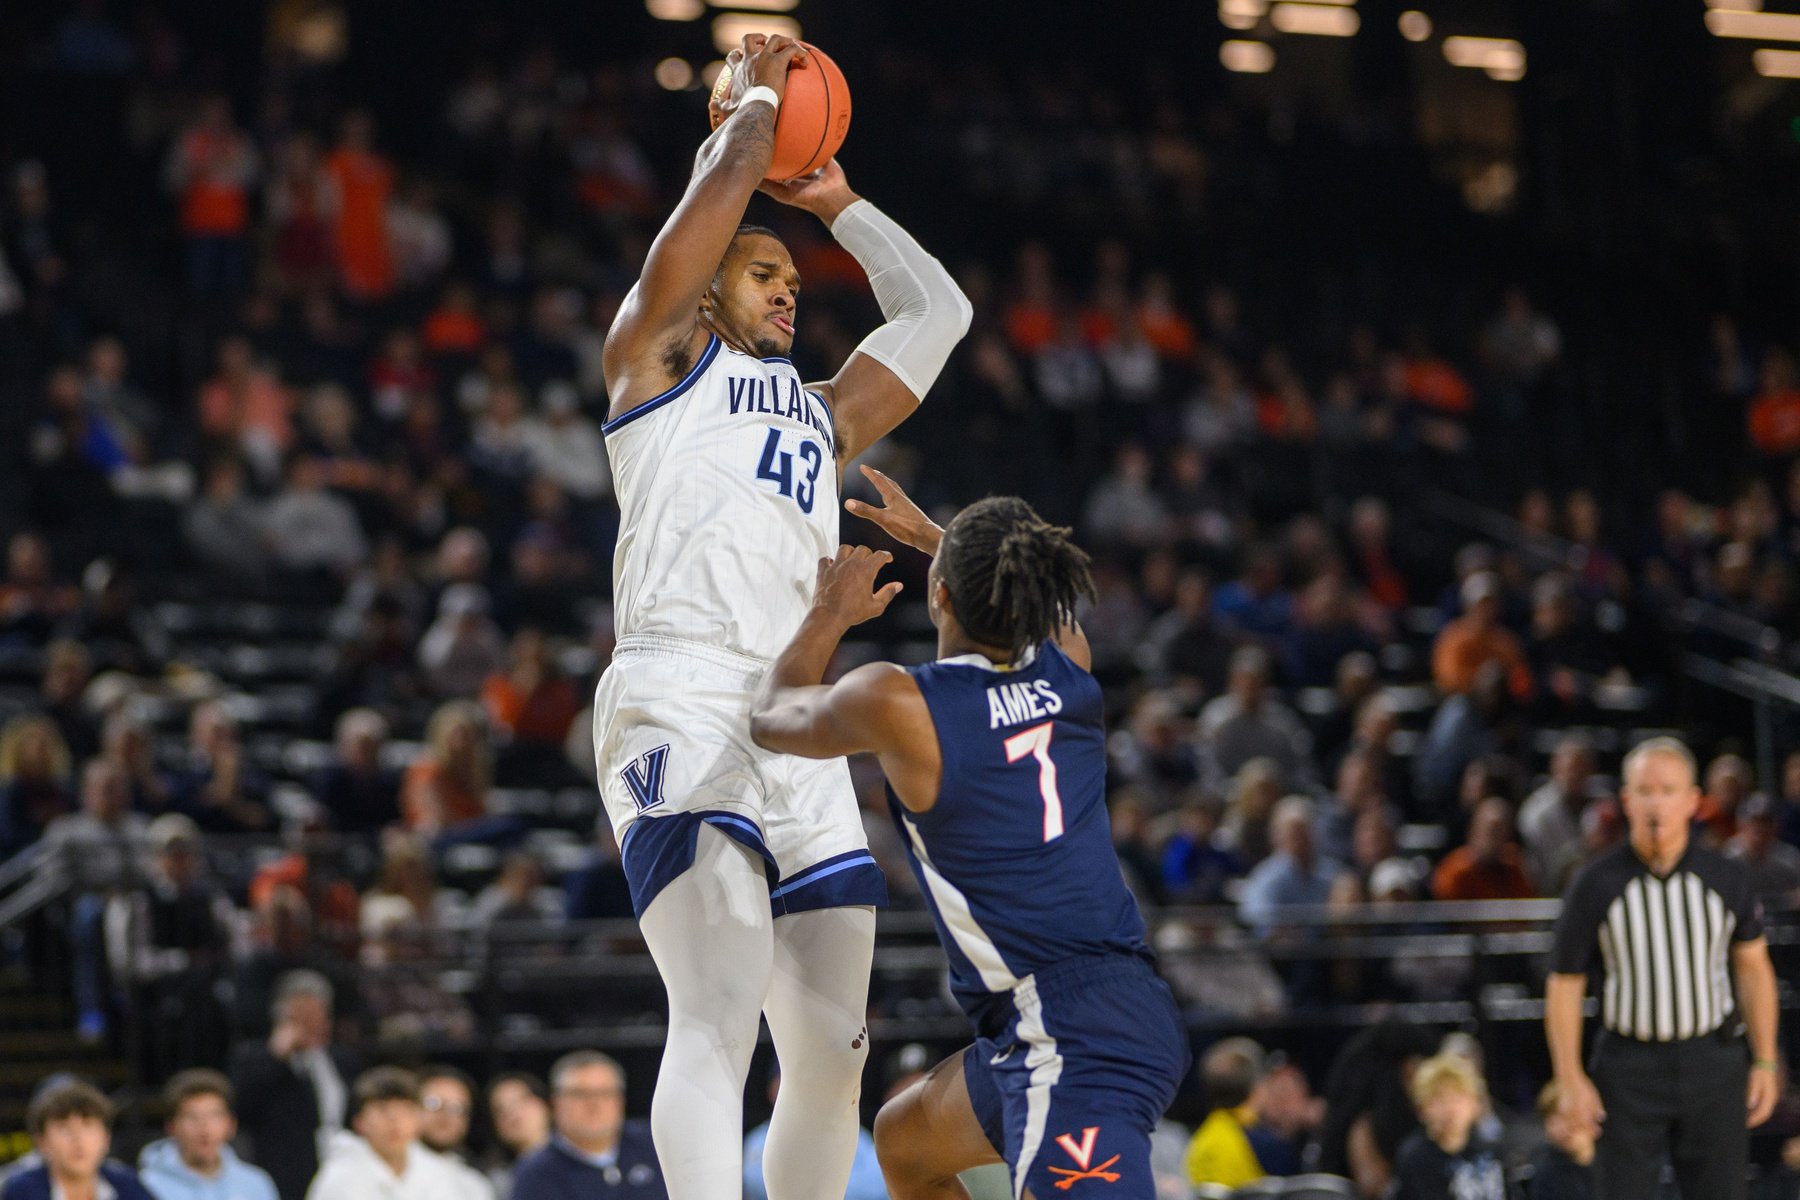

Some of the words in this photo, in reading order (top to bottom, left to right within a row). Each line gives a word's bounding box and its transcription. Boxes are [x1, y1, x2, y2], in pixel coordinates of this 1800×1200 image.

[756, 425, 822, 515] 43
[986, 678, 1063, 730] AMES
[620, 743, 671, 816] V
[1003, 720, 1064, 843] 7
[1055, 1126, 1100, 1171] V
